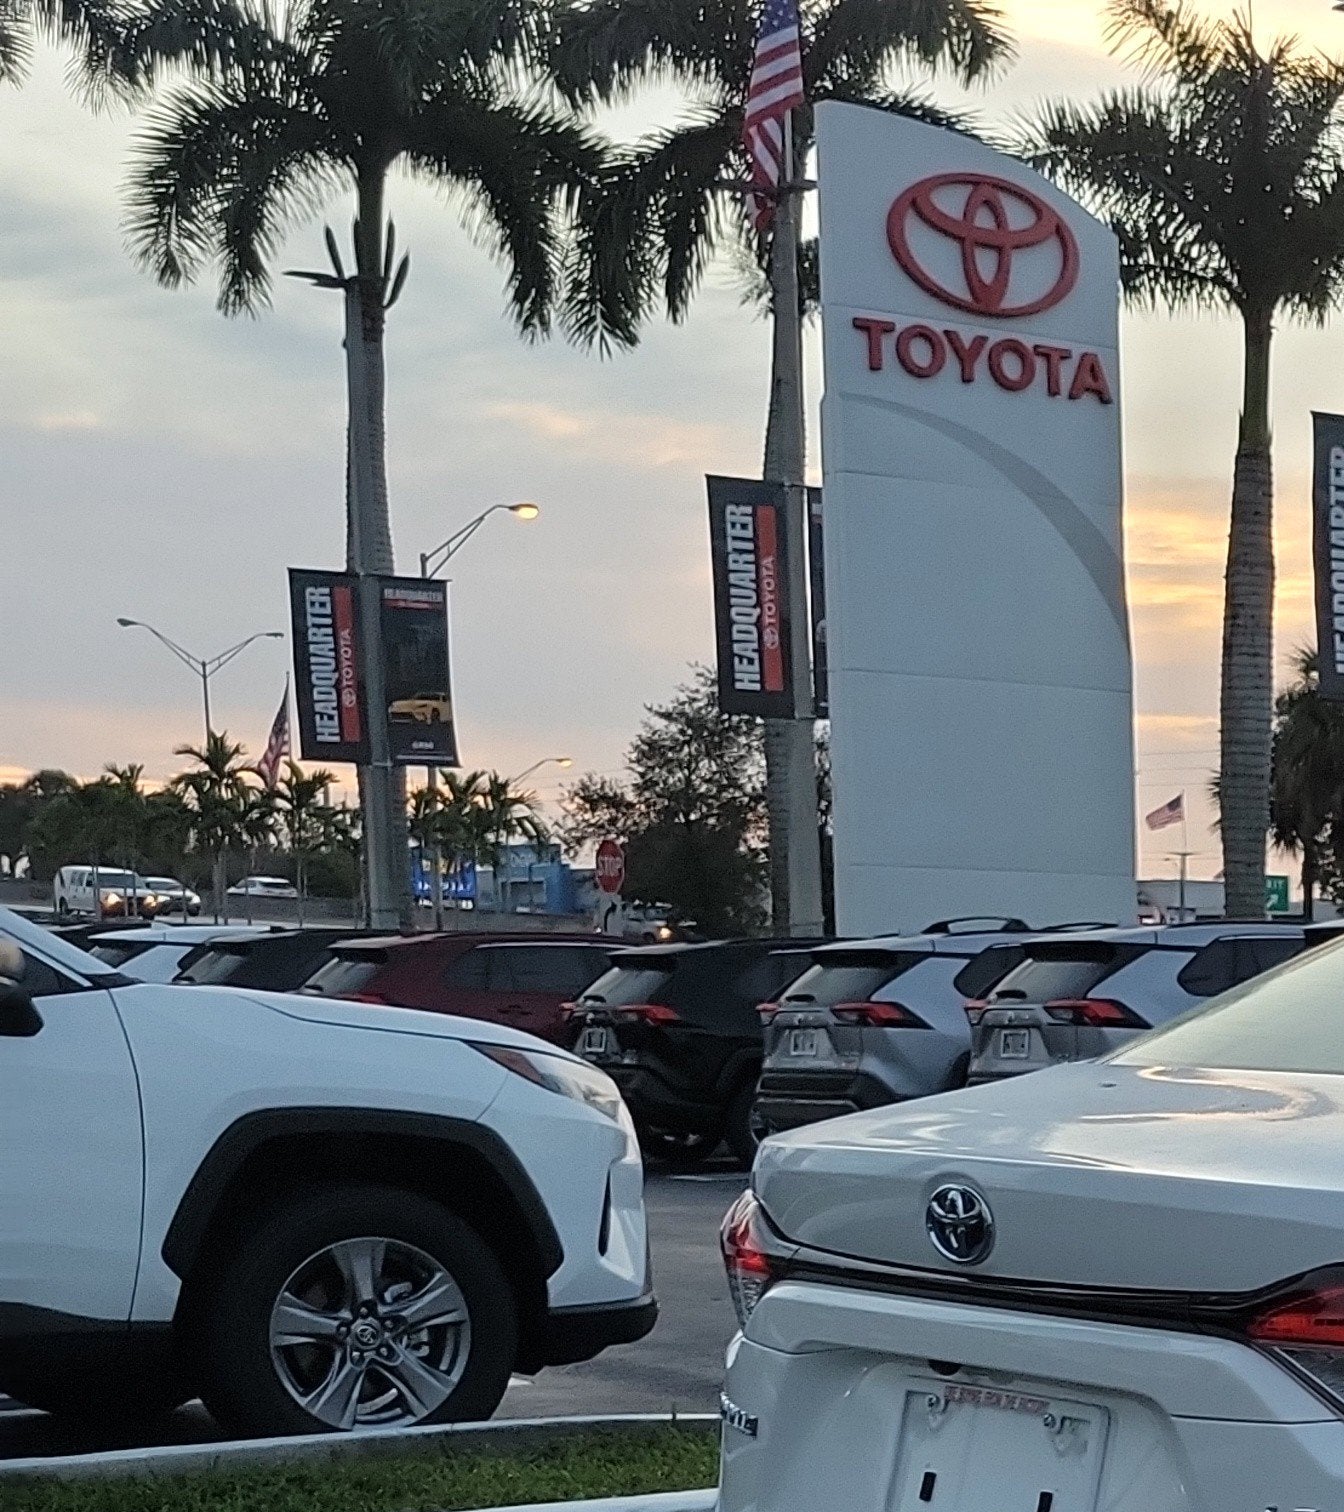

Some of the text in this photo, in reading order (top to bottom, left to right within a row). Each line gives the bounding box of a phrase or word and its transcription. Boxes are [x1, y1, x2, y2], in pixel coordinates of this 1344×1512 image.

[852, 316, 1113, 404] TOYOTA
[725, 504, 762, 691] HEADQUARTER
[761, 555, 777, 628] TOYOTA
[305, 586, 341, 742] HEADQUARTER
[340, 628, 354, 688] TOYOTA
[598, 855, 622, 877] STOP
